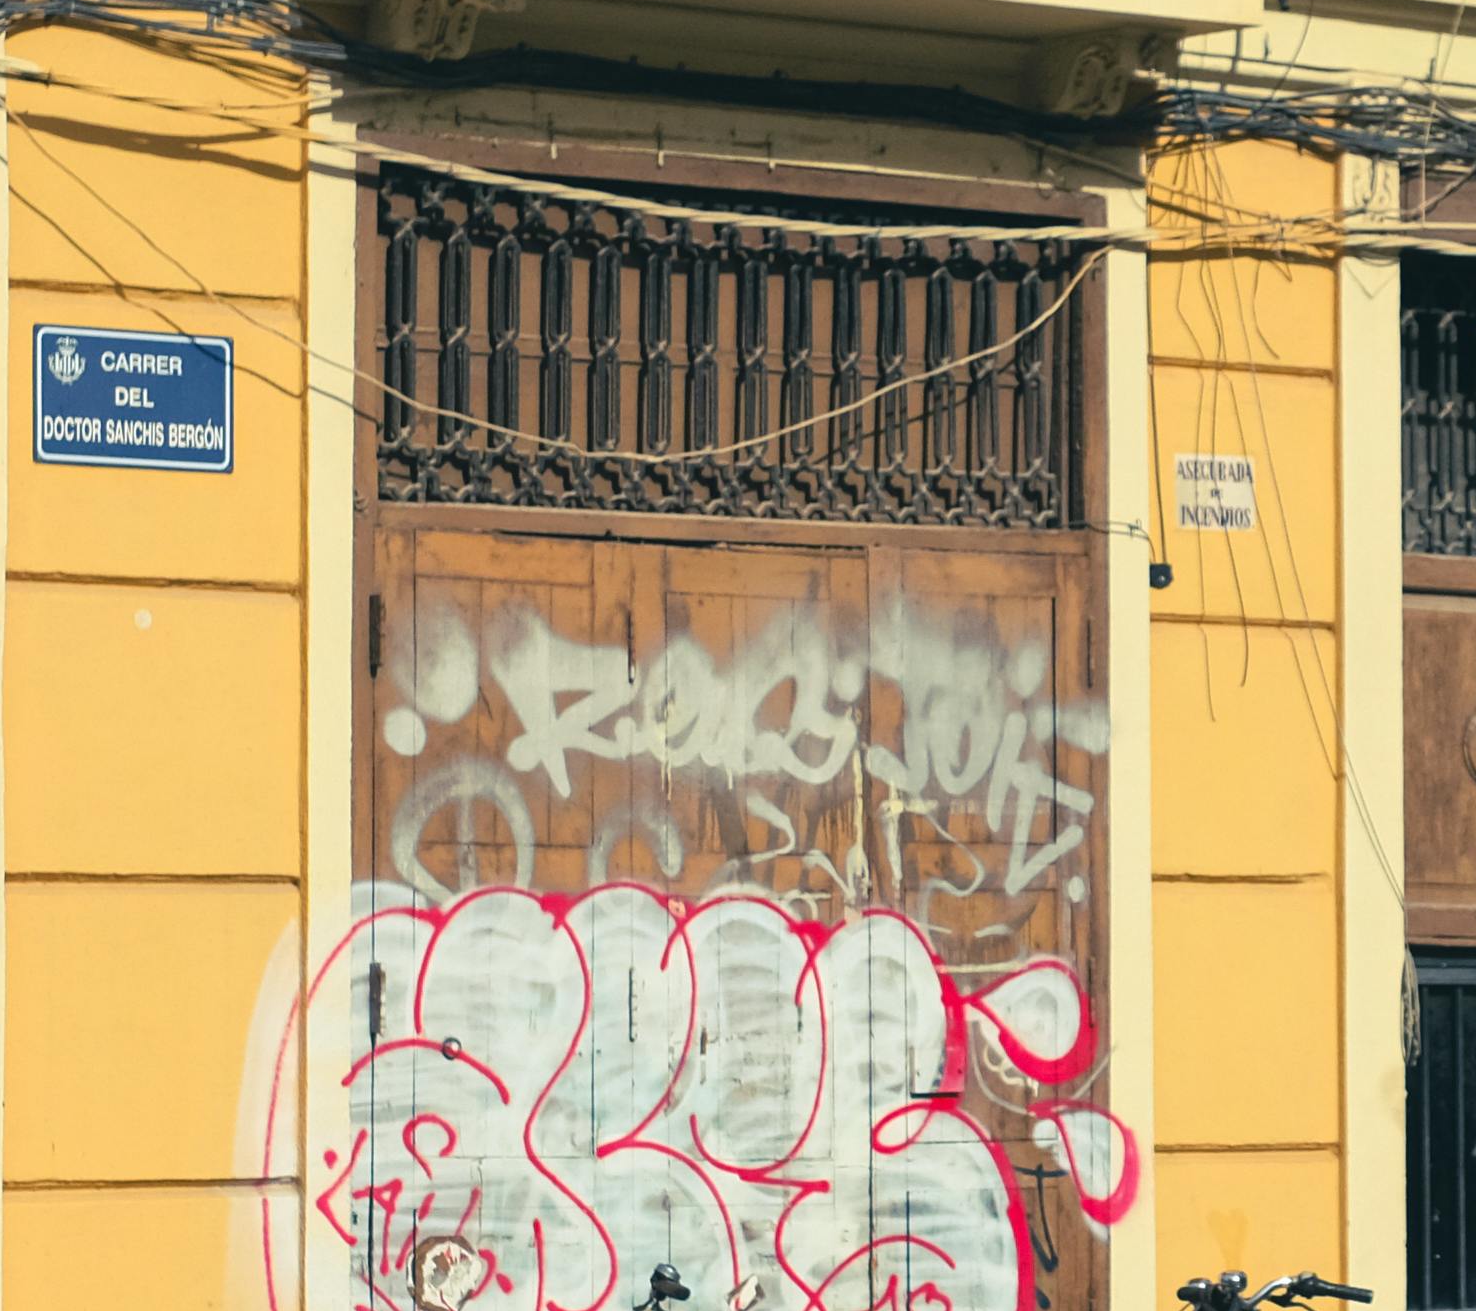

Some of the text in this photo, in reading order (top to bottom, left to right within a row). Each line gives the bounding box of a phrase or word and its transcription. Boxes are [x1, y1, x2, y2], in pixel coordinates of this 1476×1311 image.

[100, 350, 183, 377] CARRER
[114, 386, 155, 408] DEL
[43, 415, 224, 450] DOCTOR SANCHIS BERGÓN
[1180, 504, 1252, 529] INCENDIOS
